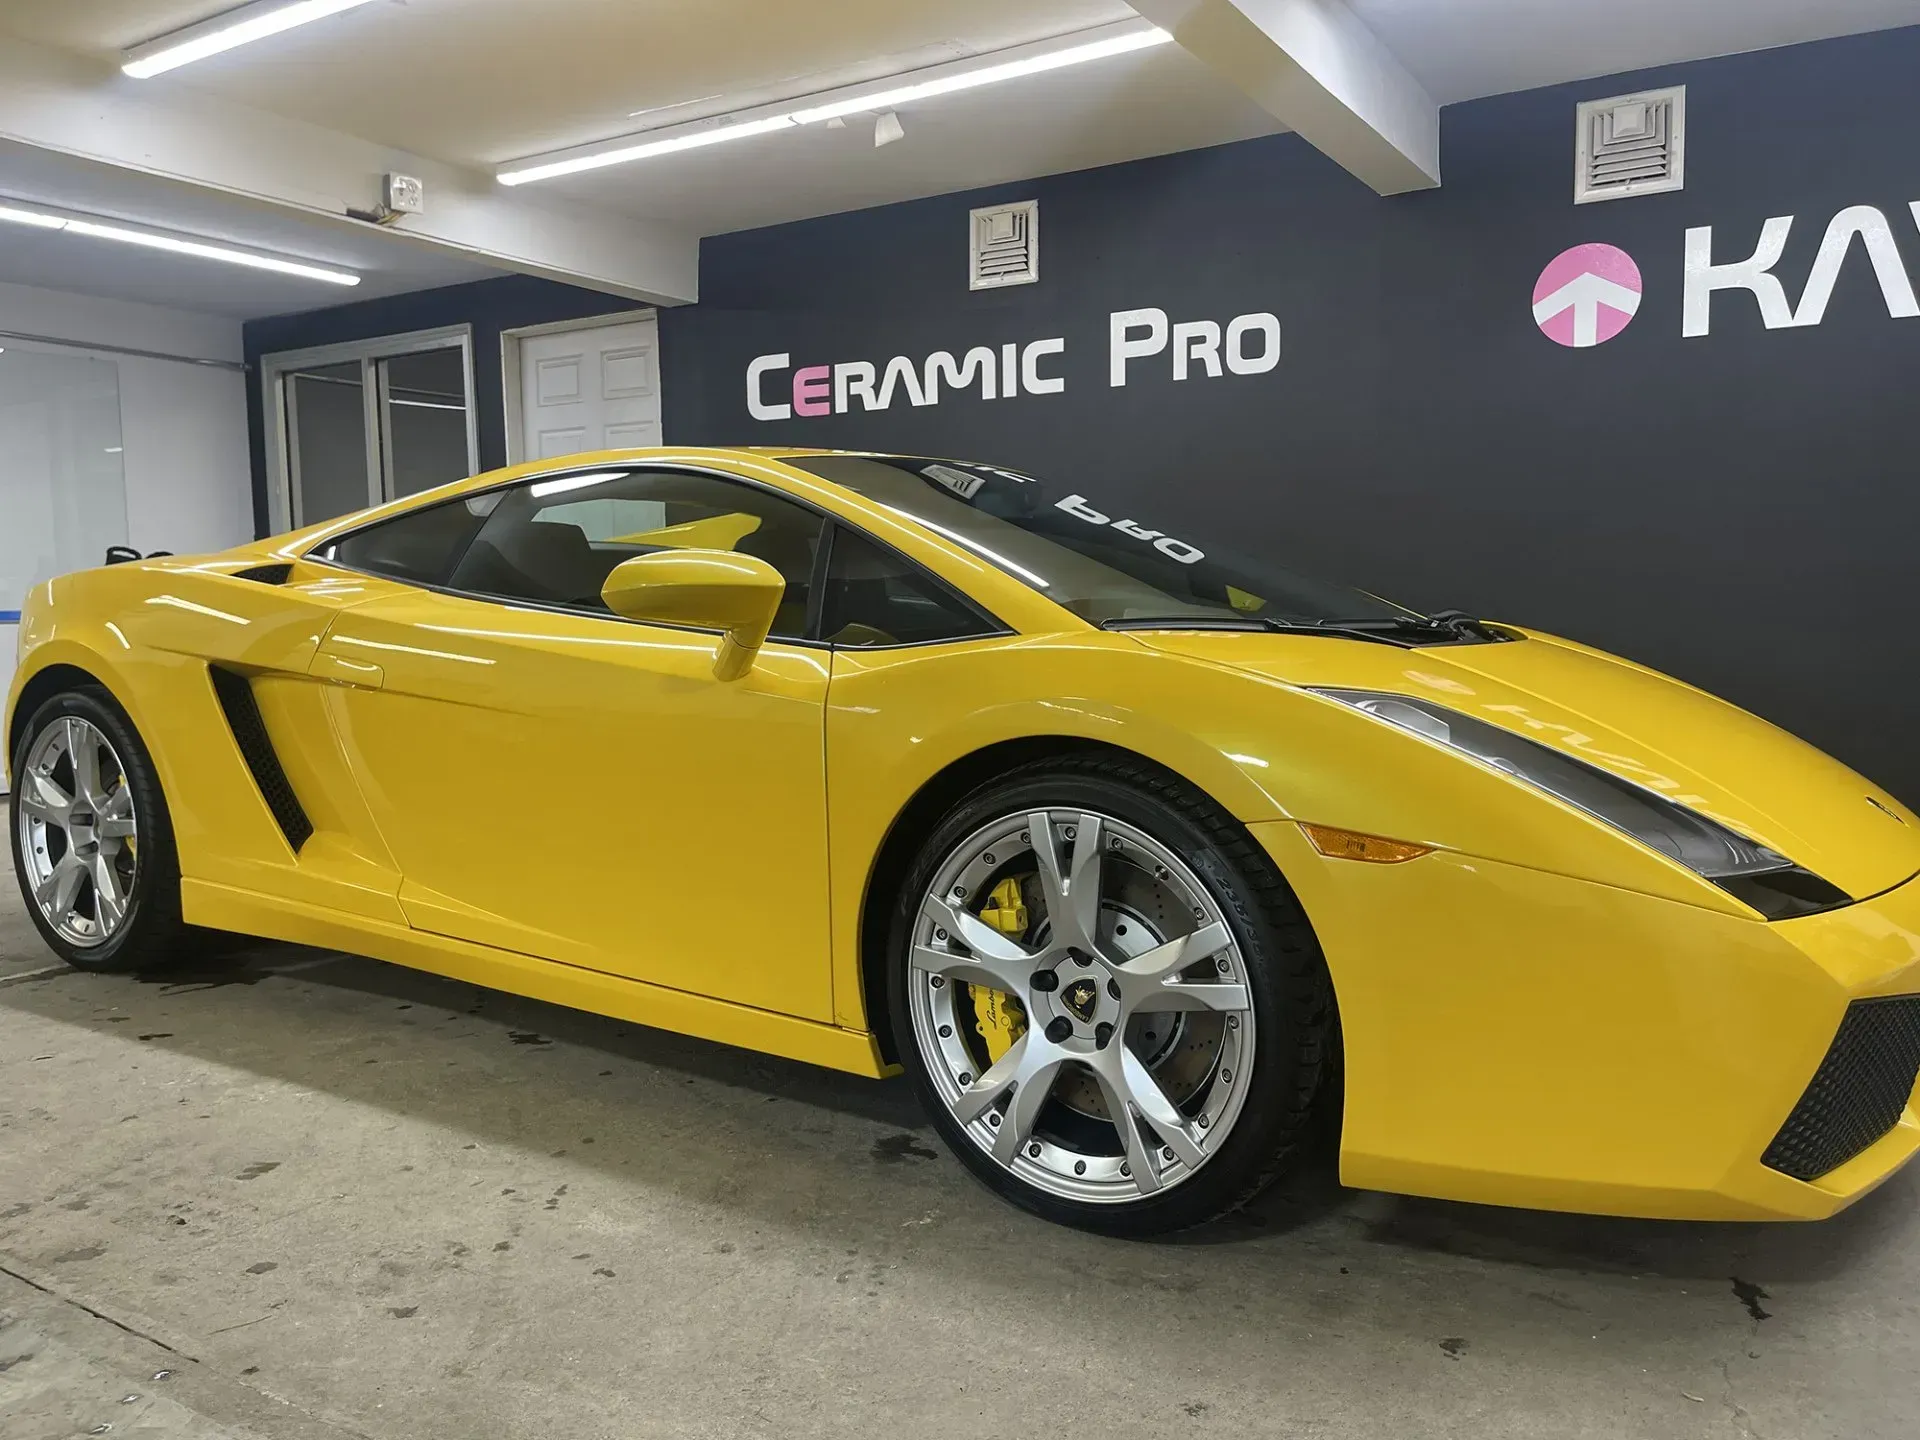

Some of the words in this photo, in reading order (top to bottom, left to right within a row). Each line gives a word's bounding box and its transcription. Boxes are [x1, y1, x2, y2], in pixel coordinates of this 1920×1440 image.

[1682, 200, 1920, 338] KA
[746, 337, 1065, 421] CERAMIC
[1110, 307, 1281, 387] PRO
